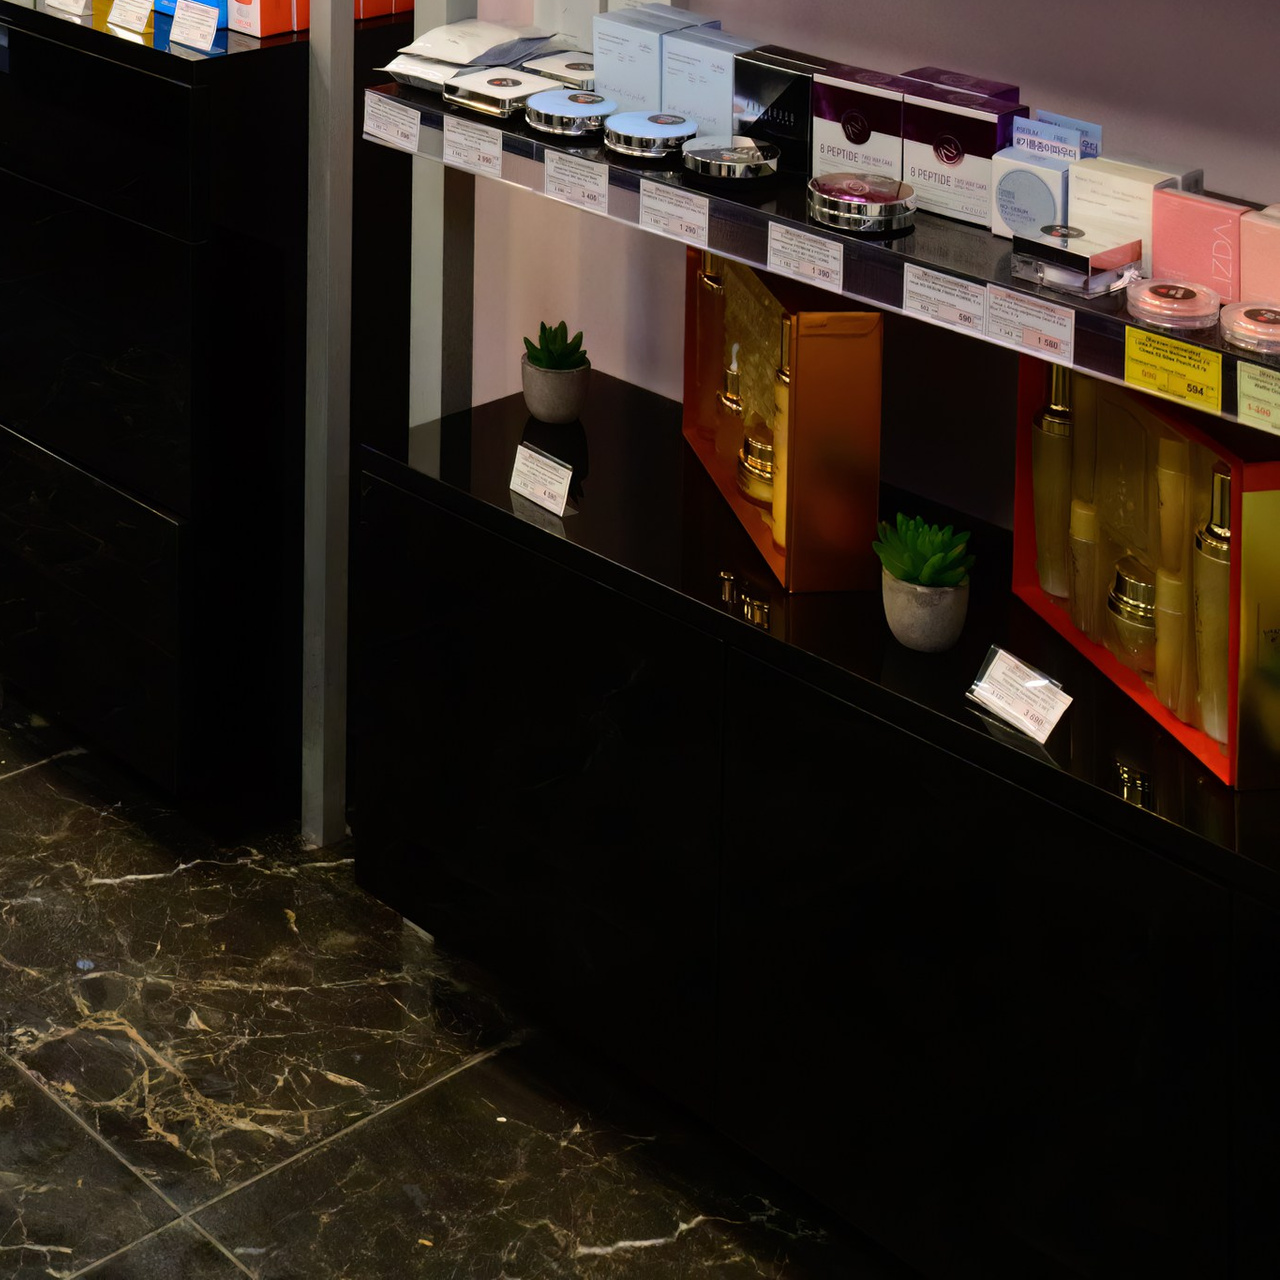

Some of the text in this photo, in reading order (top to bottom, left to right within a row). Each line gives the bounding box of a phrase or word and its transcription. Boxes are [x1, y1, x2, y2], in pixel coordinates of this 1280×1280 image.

[826, 145, 859, 163] PEPTIDE
[917, 168, 951, 187] PEPTIDE
[958, 313, 972, 323] 590
[1187, 383, 1204, 396] 594
